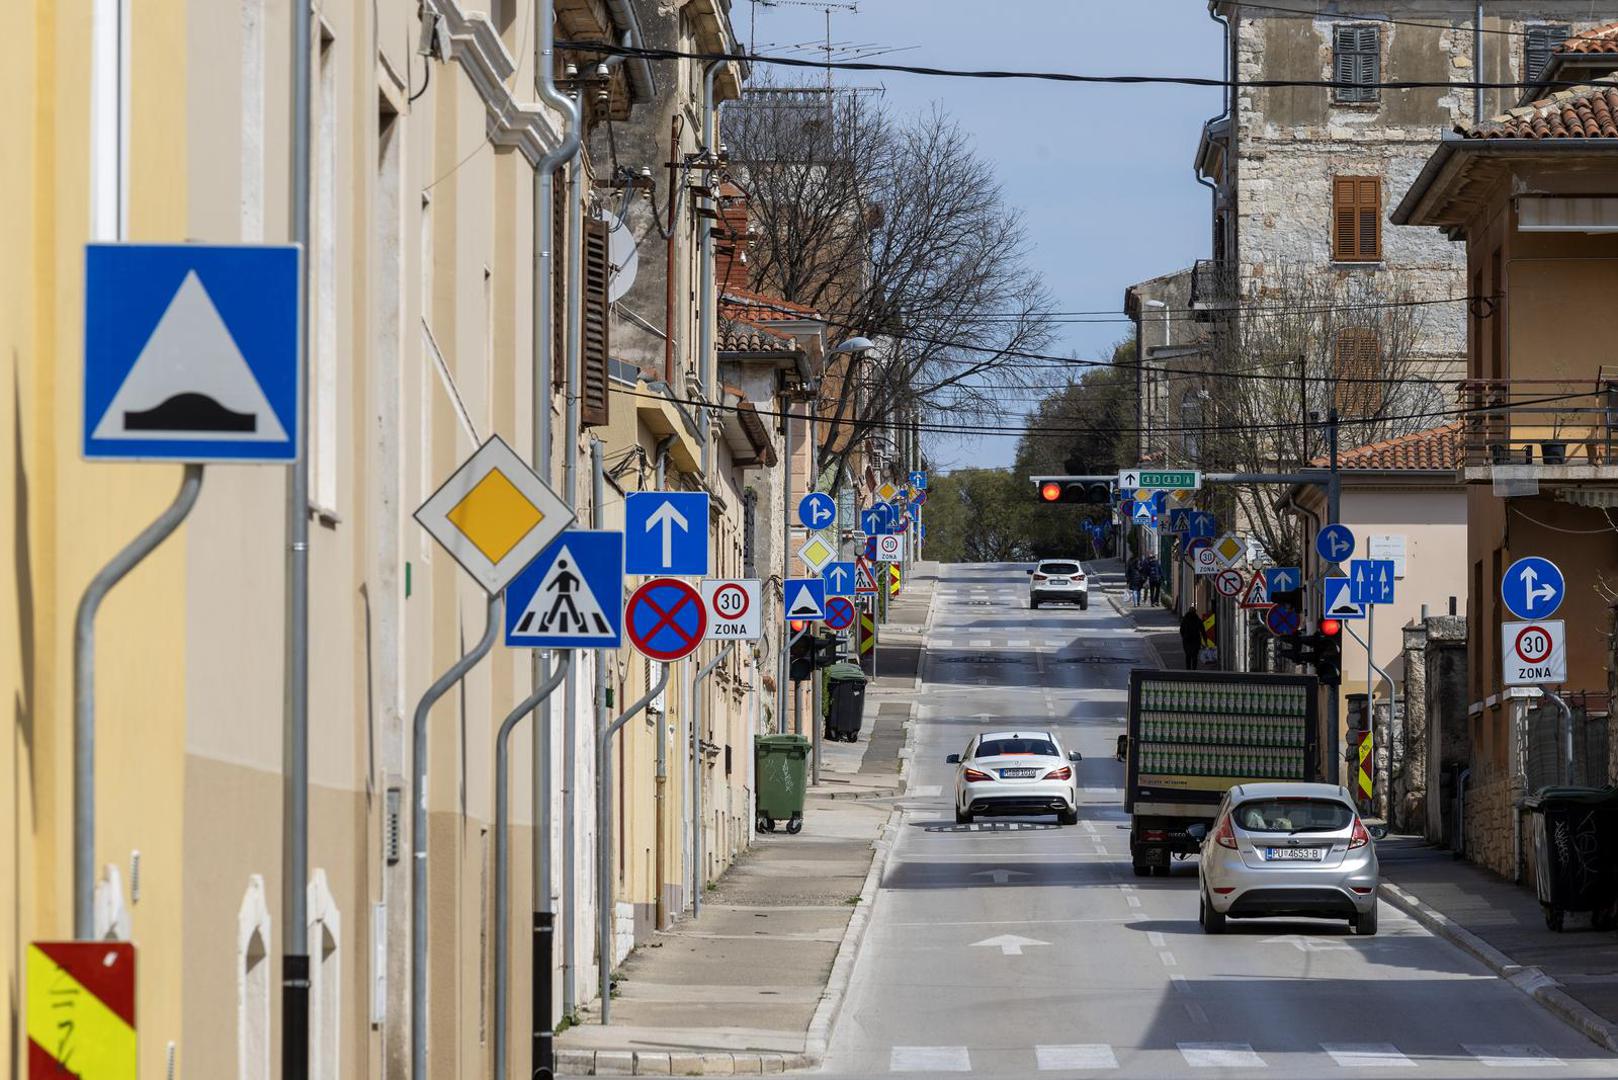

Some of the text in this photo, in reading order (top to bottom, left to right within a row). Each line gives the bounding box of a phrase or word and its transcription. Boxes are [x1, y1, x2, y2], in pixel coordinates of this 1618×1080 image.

[885, 540, 894, 549] 30
[1203, 553, 1212, 561] 30
[721, 593, 741, 610] 30
[715, 624, 747, 635] ZONA
[1524, 636, 1544, 653] 30
[1519, 667, 1551, 679] ZONA
[1273, 849, 1284, 858] PU
